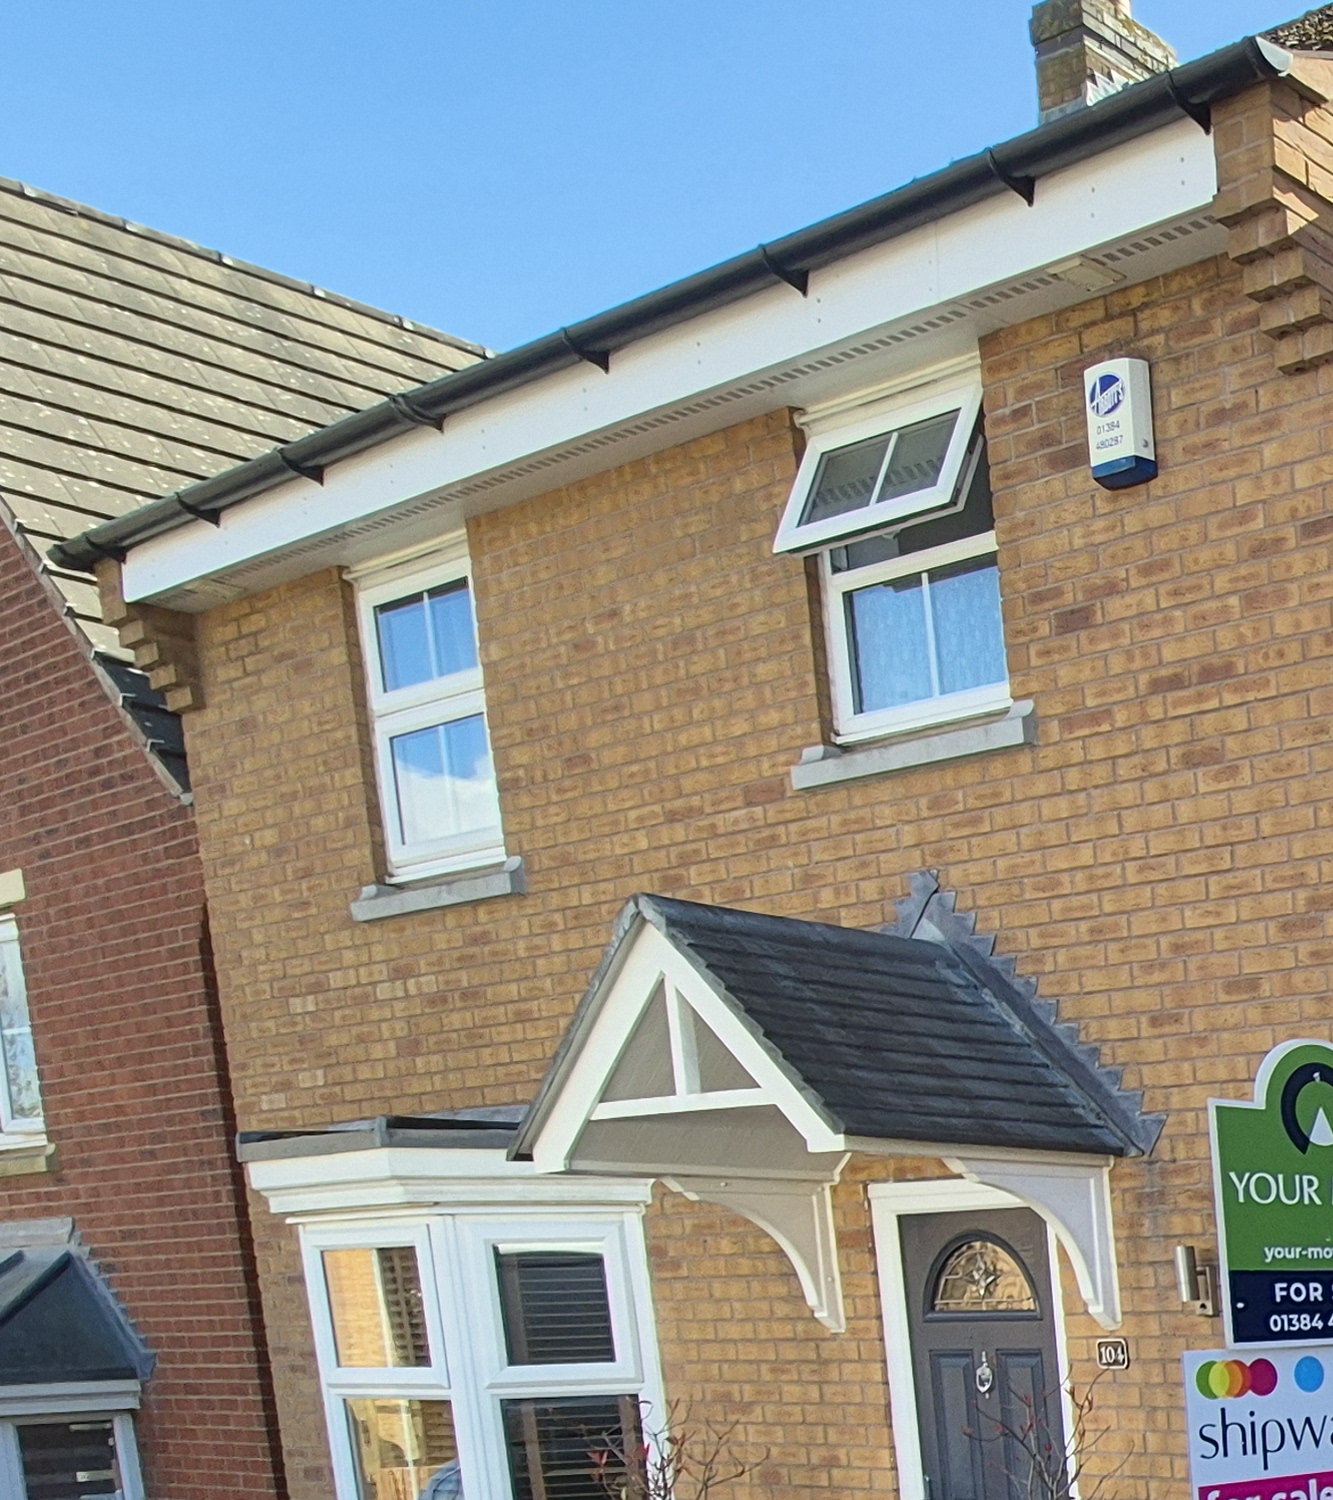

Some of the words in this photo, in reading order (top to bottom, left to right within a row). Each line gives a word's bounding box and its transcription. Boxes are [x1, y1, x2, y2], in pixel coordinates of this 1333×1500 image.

[1096, 420, 1120, 435] 01384
[1229, 1172, 1322, 1206] YOUR
[1274, 1282, 1323, 1302] FOR
[1269, 1313, 1323, 1332] 01384
[1100, 1346, 1124, 1364] 104
